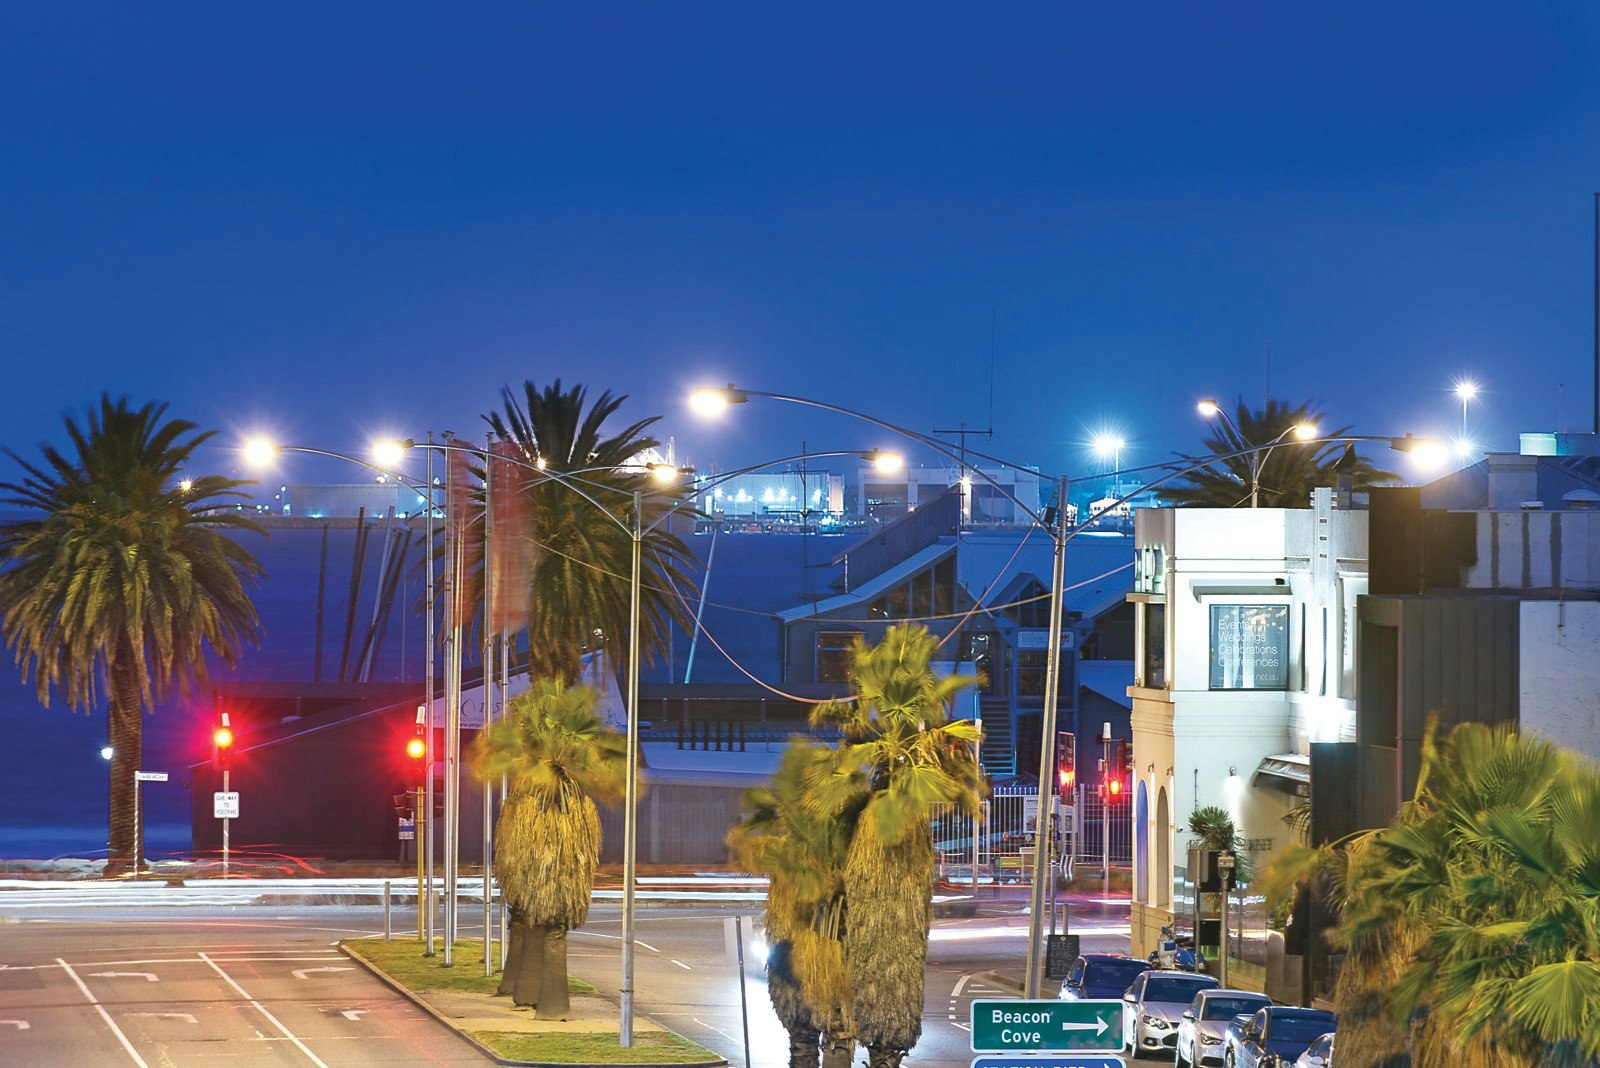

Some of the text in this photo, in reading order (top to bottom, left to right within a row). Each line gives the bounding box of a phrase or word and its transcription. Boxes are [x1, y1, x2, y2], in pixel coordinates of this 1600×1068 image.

[1218, 619, 1250, 630] Events
[1218, 632, 1267, 644] Weddings
[1218, 644, 1278, 655] Celebrations
[1218, 656, 1280, 667] Conferences
[992, 1009, 1050, 1024] Beacon
[1001, 1029, 1041, 1043] Cove
